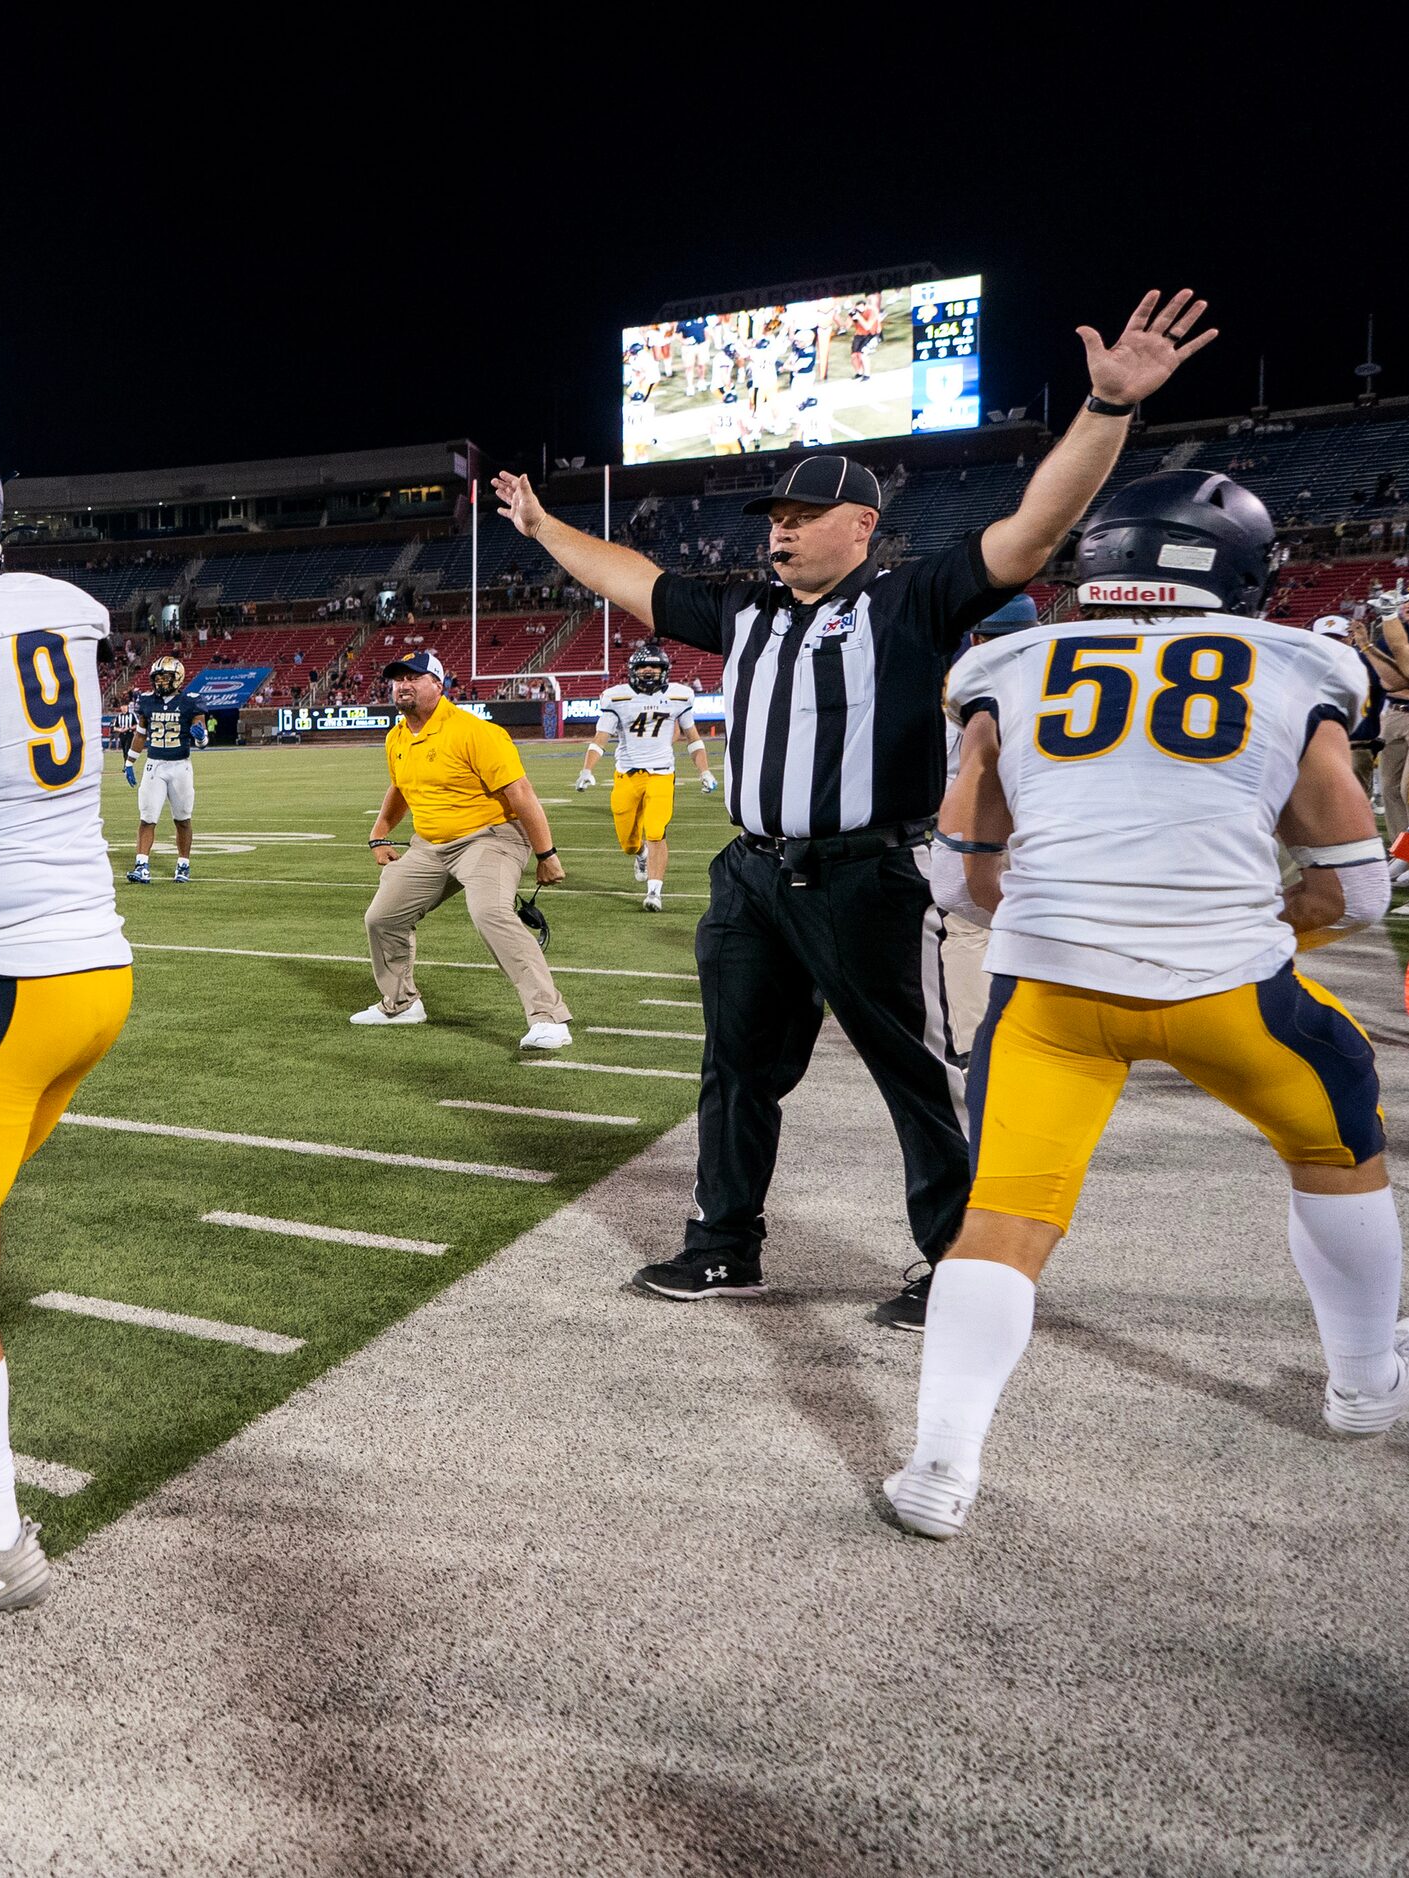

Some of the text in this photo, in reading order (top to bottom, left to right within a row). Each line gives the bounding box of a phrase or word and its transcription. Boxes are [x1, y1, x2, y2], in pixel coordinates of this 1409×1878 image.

[1089, 585, 1176, 602] Riddell
[11, 628, 86, 792] 9
[1033, 631, 1258, 765] 58
[150, 712, 182, 722] JESUIT
[629, 711, 672, 738] 47
[150, 721, 182, 749] 22
